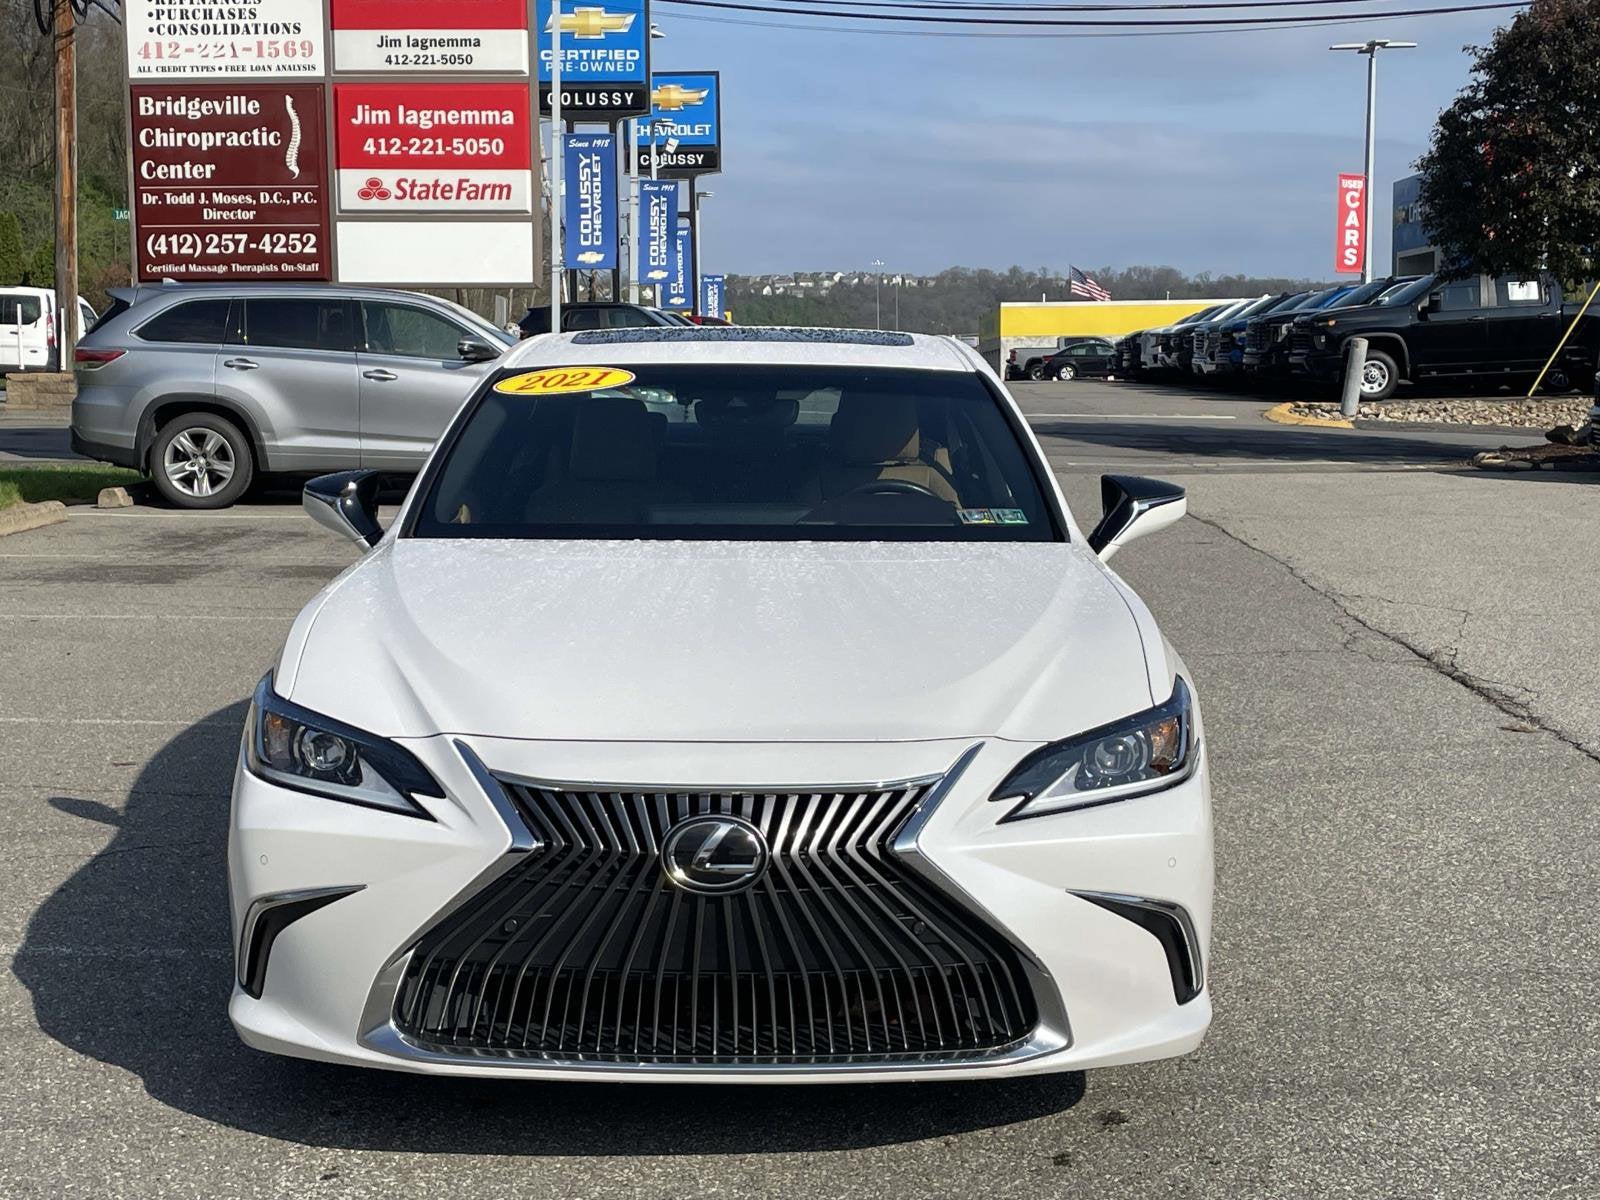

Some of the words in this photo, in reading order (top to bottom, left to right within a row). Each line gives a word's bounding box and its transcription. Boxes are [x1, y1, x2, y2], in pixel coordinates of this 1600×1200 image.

[155, 8, 257, 20] PURCHASES
[156, 22, 301, 36] CONSOLIDATIONS
[137, 40, 314, 60] 412-221-1569
[377, 35, 401, 48] Jim
[385, 54, 473, 66] 412-221-5050
[540, 49, 640, 61] CERTIFIED
[190, 65, 216, 73] TYPES
[275, 64, 316, 72] ANALYSIS
[138, 96, 260, 120] Bridgeville
[547, 92, 634, 106] COLUSSY
[351, 105, 391, 125] Jim
[138, 127, 281, 151] Chiropractic
[363, 138, 504, 156] 412-221-5050
[568, 139, 589, 148] Since
[592, 139, 610, 148] 1918
[140, 160, 216, 179] Center
[142, 193, 162, 205] Dr.
[164, 192, 195, 205] Todd
[198, 193, 209, 205] J.
[212, 192, 256, 205] Moses,
[579, 153, 591, 246] COLUSSY
[592, 153, 602, 245] CHEVROLET
[203, 208, 256, 220] Director
[650, 195, 660, 266] COLUSSY
[660, 195, 668, 266] CHEVROLET
[1343, 190, 1361, 266] CARS
[146, 263, 186, 273] Certified
[188, 263, 228, 274] Massage
[231, 263, 279, 274] Therapists
[281, 263, 319, 272] On-Staff
[515, 372, 612, 391] 2021
